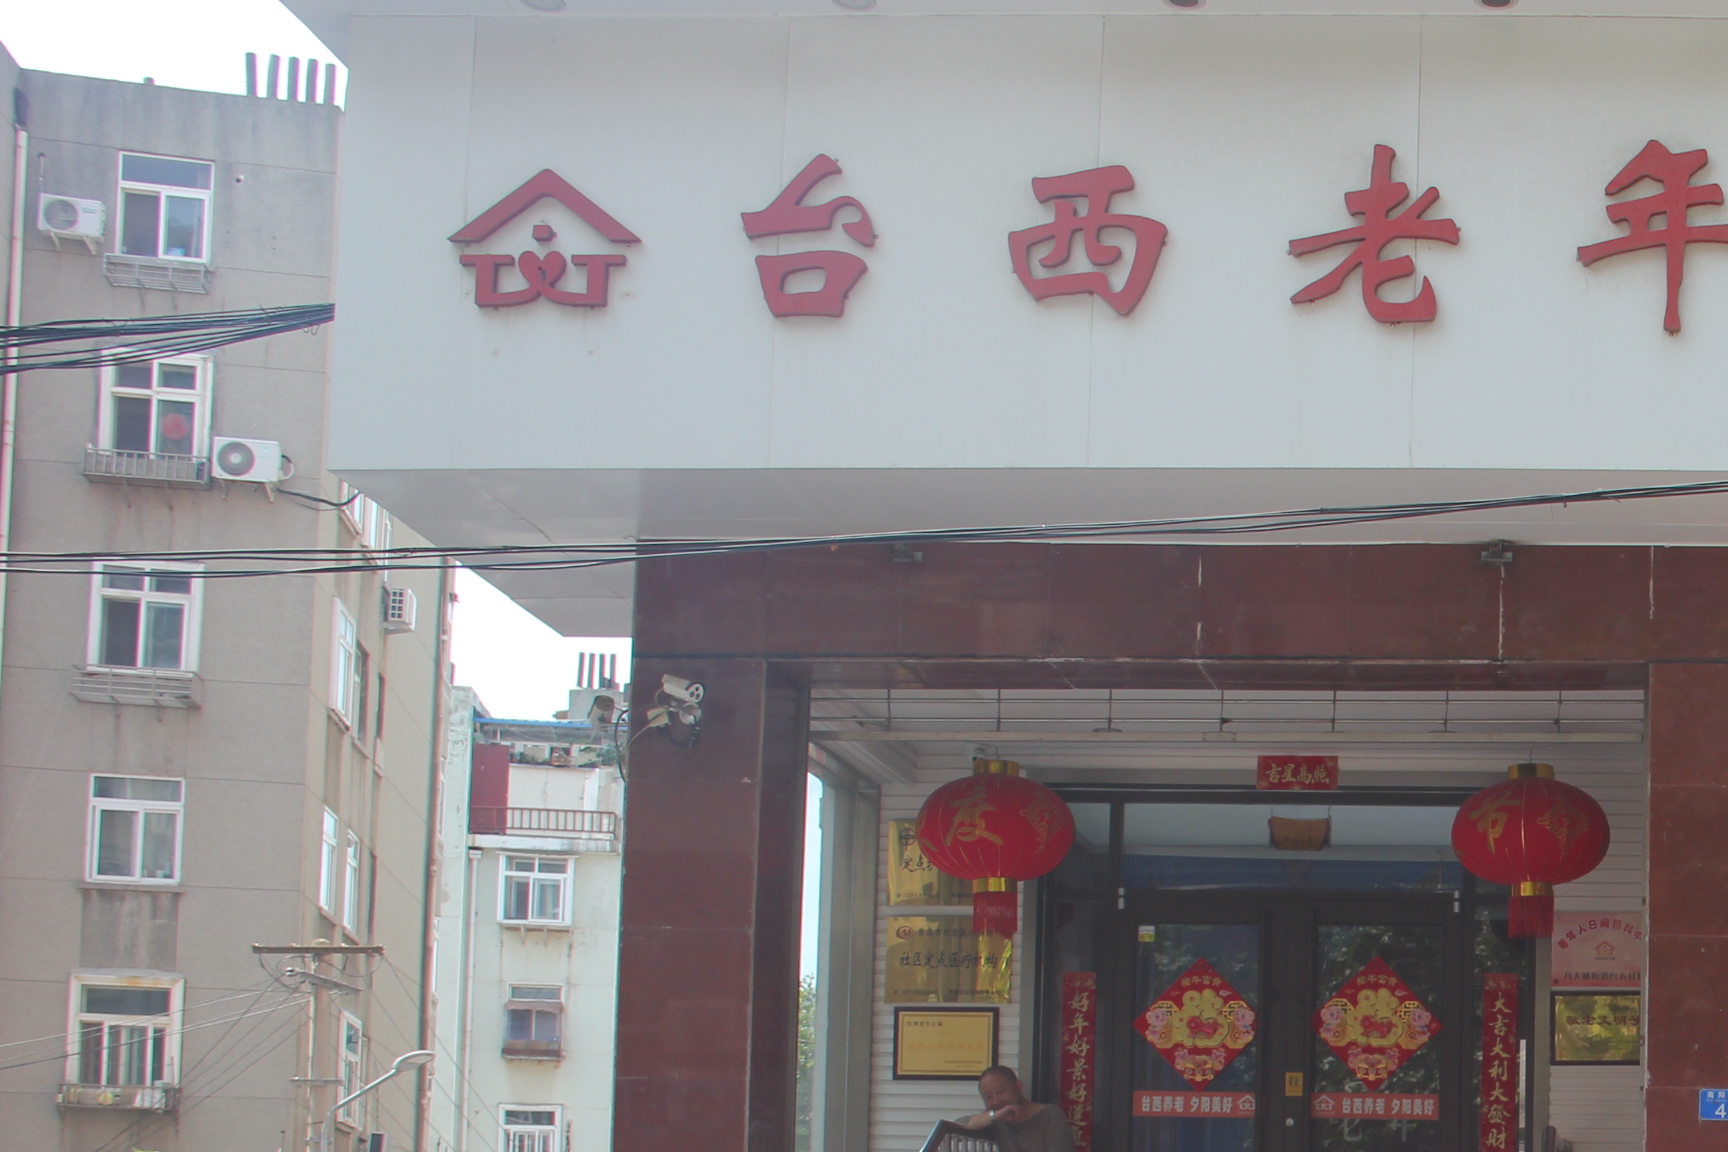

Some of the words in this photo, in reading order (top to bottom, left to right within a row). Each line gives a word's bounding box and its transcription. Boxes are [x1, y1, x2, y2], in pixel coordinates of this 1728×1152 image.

[1266, 763, 1330, 784] 吉星高照
[899, 952, 998, 969] 社区定点医疗机构
[1485, 991, 1513, 1150] 大吉大利大發財
[1141, 1095, 1185, 1113] 台西养老
[1190, 1096, 1233, 1114] 夕阳美好
[1342, 1097, 1386, 1115] 台西养老
[1391, 1098, 1434, 1116] 夕阳美好
[1714, 1103, 1727, 1119] 4
